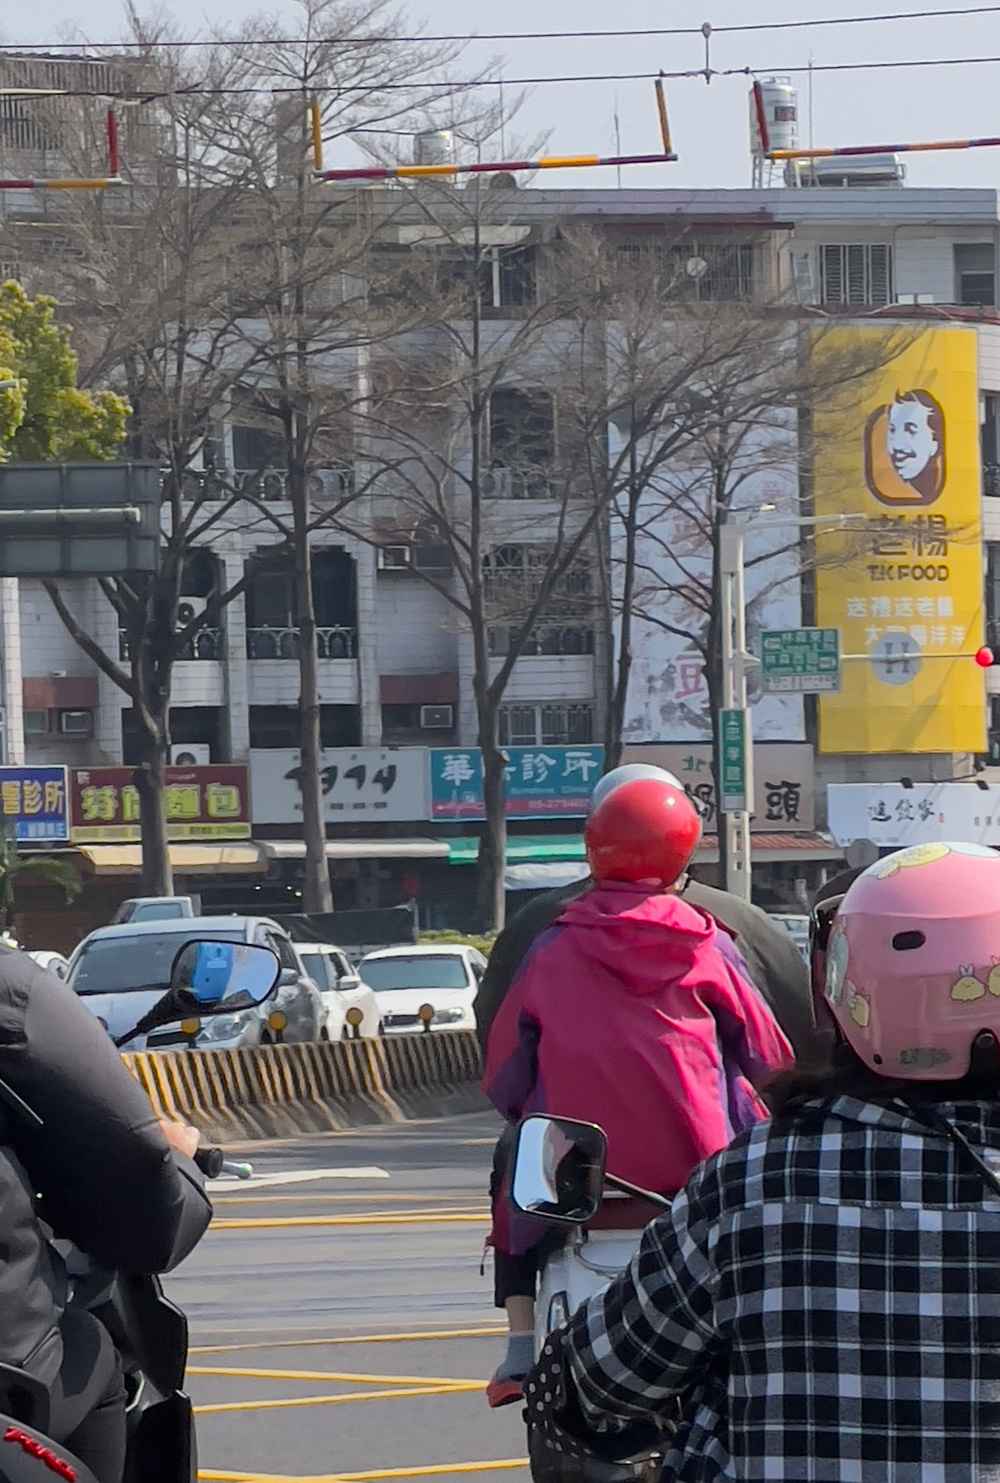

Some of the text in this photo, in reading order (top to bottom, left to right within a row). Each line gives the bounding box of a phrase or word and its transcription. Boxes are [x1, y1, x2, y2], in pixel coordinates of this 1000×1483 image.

[898, 564, 950, 582] FOOD
[440, 751, 599, 787] 華診所
